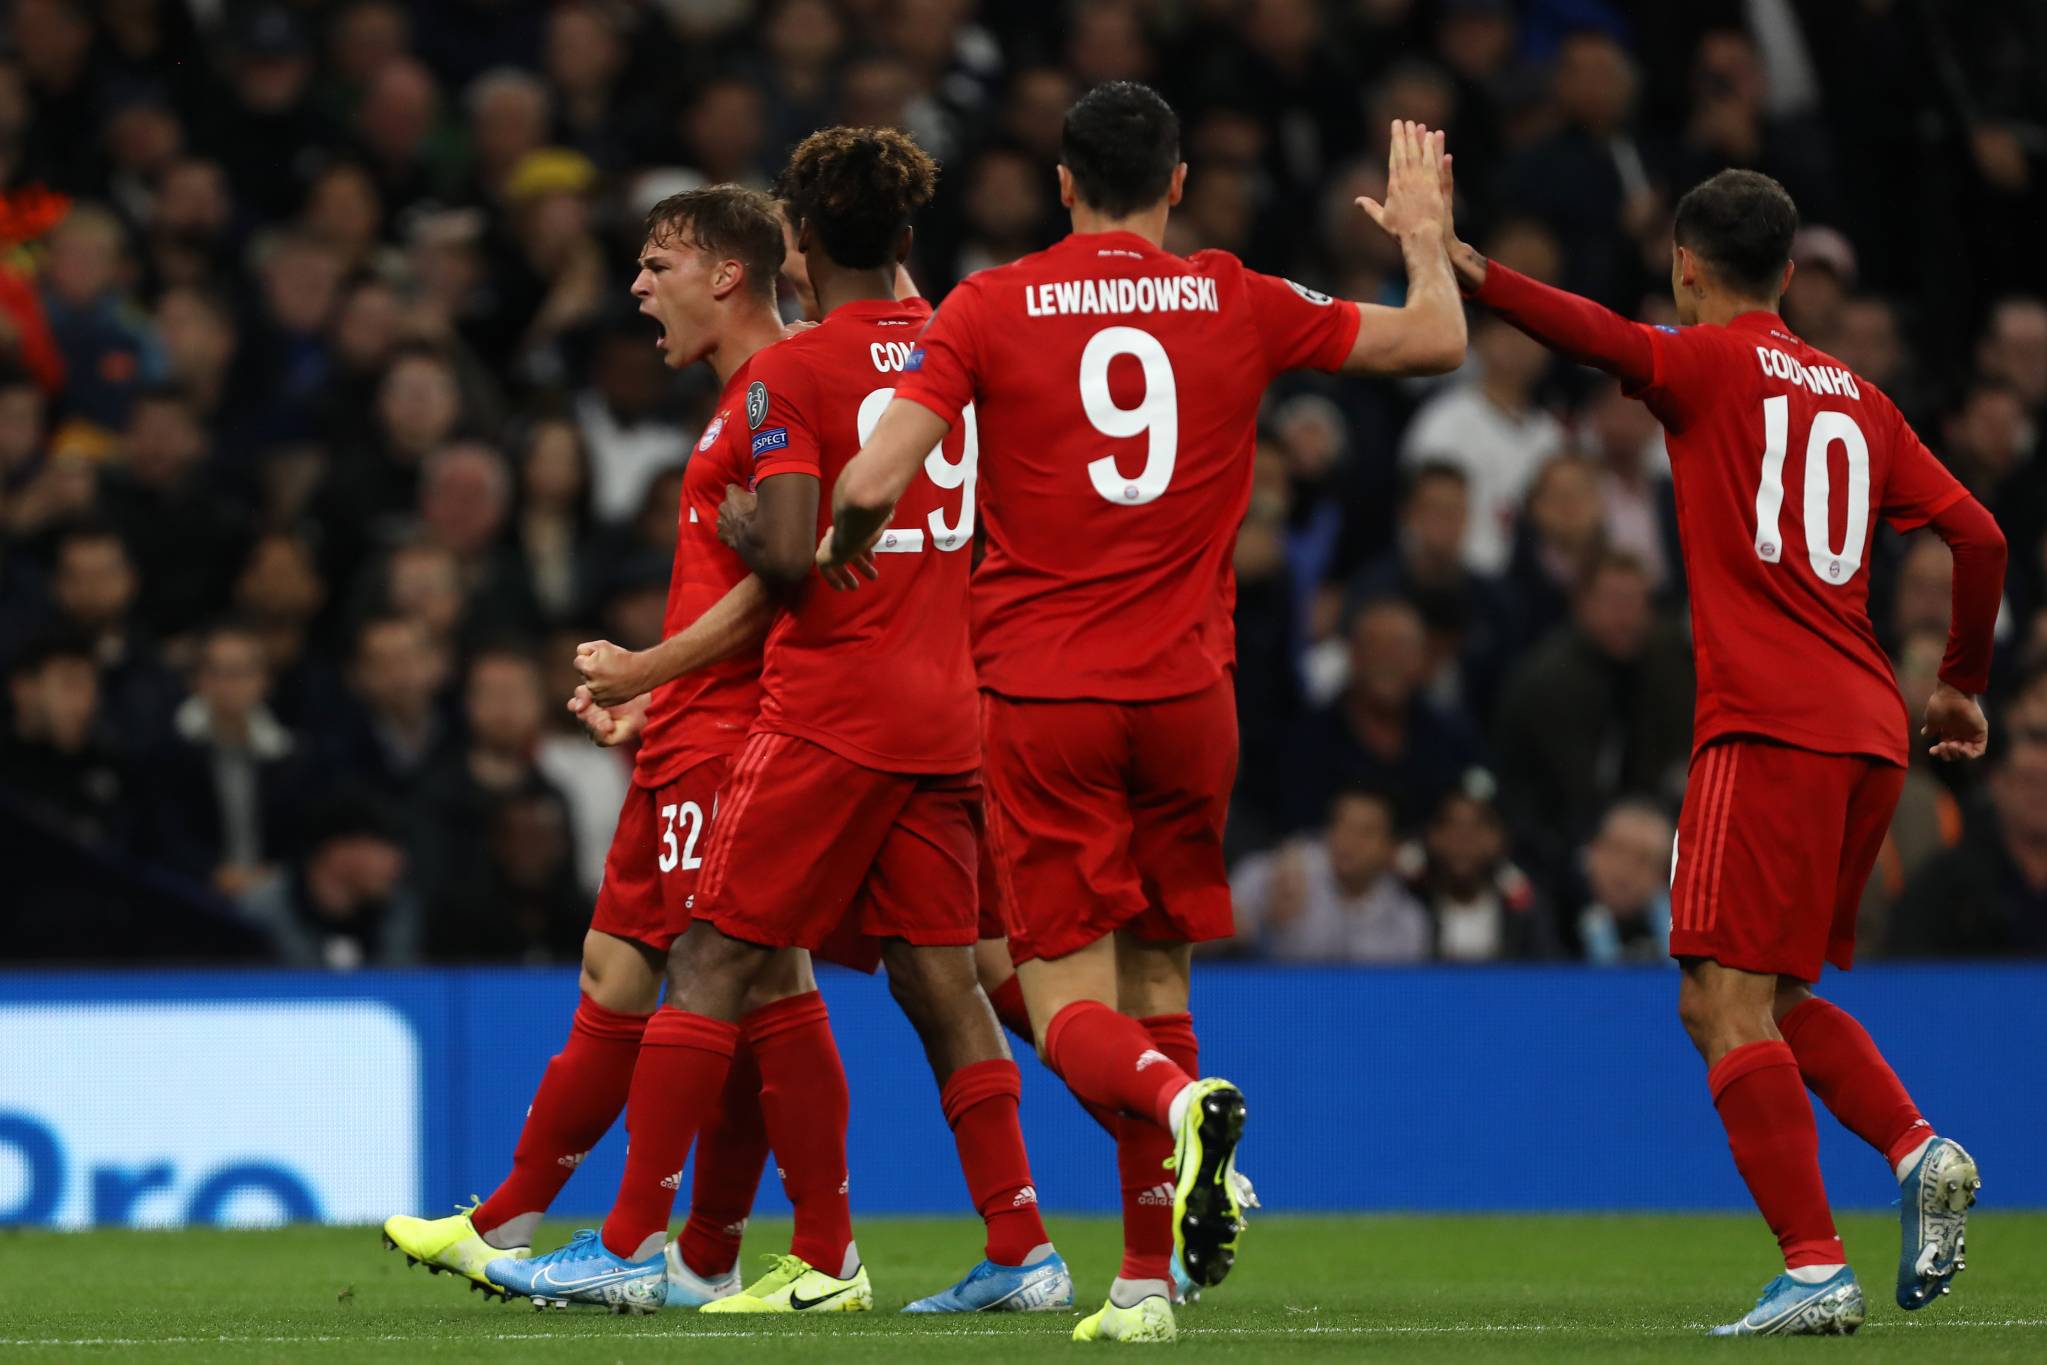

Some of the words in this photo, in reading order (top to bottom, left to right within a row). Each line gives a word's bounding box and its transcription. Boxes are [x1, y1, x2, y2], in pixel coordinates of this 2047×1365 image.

[1026, 276, 1219, 317] LEWANDOWSKI
[1756, 346, 1860, 401] COUINHO
[1079, 326, 1178, 506] 9
[1754, 394, 1870, 586] 10
[659, 801, 704, 873] 32
